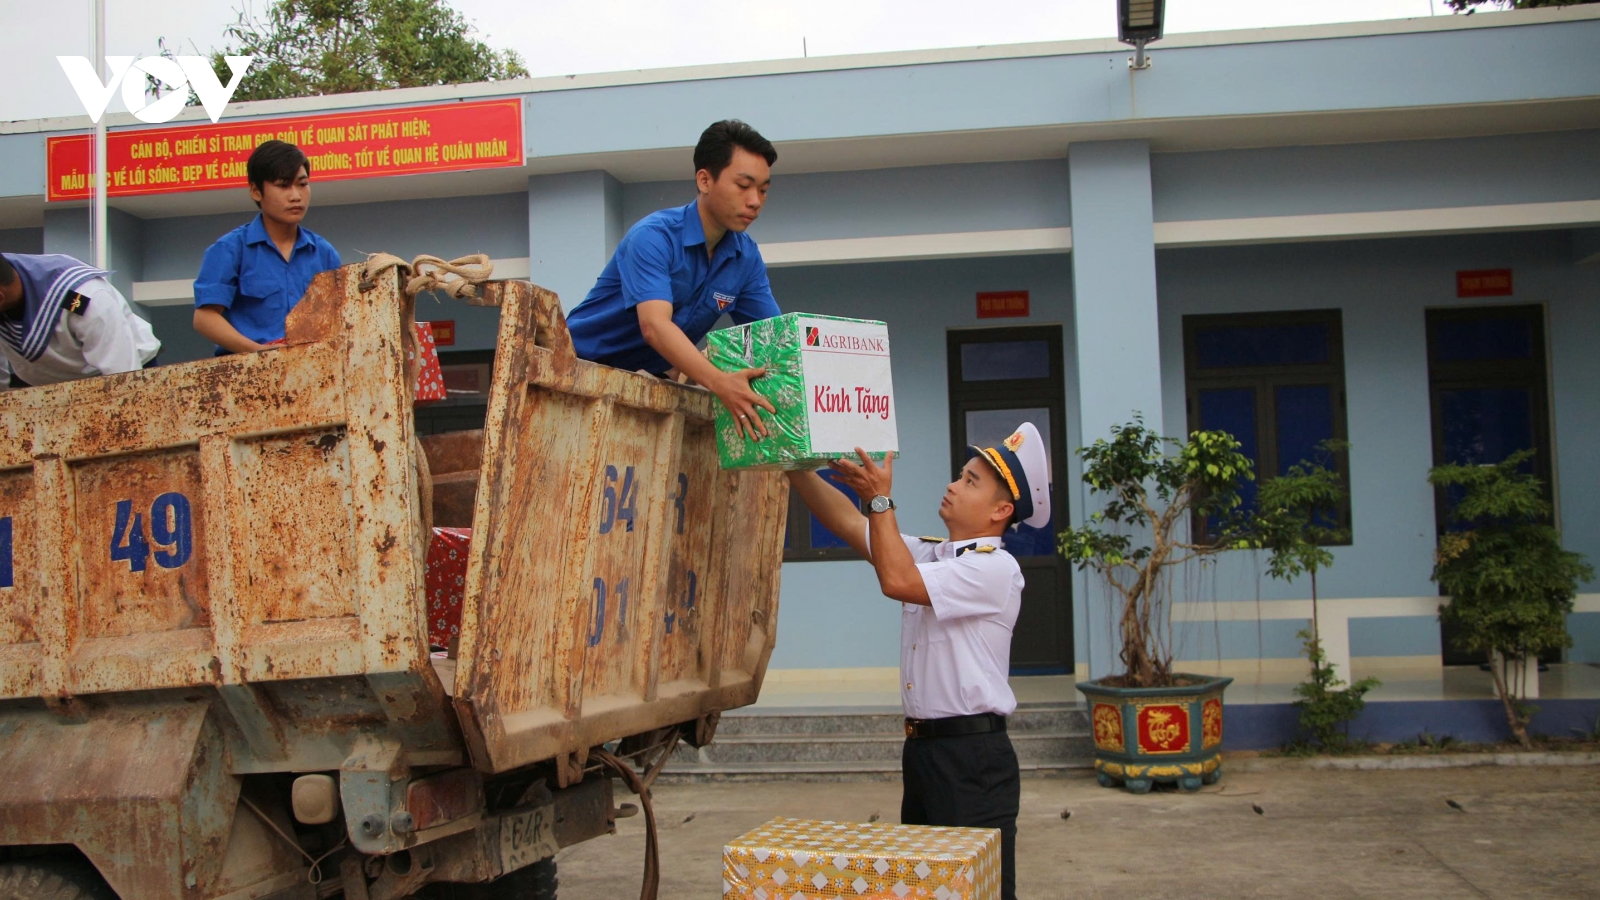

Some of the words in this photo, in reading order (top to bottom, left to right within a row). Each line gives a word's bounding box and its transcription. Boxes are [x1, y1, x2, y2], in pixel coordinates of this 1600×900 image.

[131, 140, 153, 159] CÁN
[155, 138, 172, 160] BỘ,
[175, 135, 207, 156] CHIẾN
[209, 135, 220, 153] SĨ
[222, 134, 252, 155] TRẠM
[301, 124, 314, 145] VỀ
[316, 127, 345, 145] QUAN
[348, 120, 368, 141] SÁT
[371, 120, 398, 140] PHÁT
[401, 120, 431, 140] HIỆN;
[61, 168, 85, 190] MẪU
[88, 172, 111, 188] MC
[113, 166, 127, 187] VỀ
[129, 163, 146, 184] LỐI
[148, 162, 180, 183] SỐNG;
[182, 165, 203, 185] ĐẸP
[205, 159, 218, 180] VỀ
[355, 147, 374, 168] TỐT
[376, 145, 390, 166] VỀ
[393, 148, 422, 166] QUAN
[425, 143, 439, 165] HỆ
[442, 141, 473, 161] QUÂN
[475, 138, 507, 158] NHÂN
[822, 334, 884, 352] AGRIBANK
[814, 385, 852, 413] Kính
[854, 386, 889, 420] Tặng
[110, 491, 192, 573] 49
